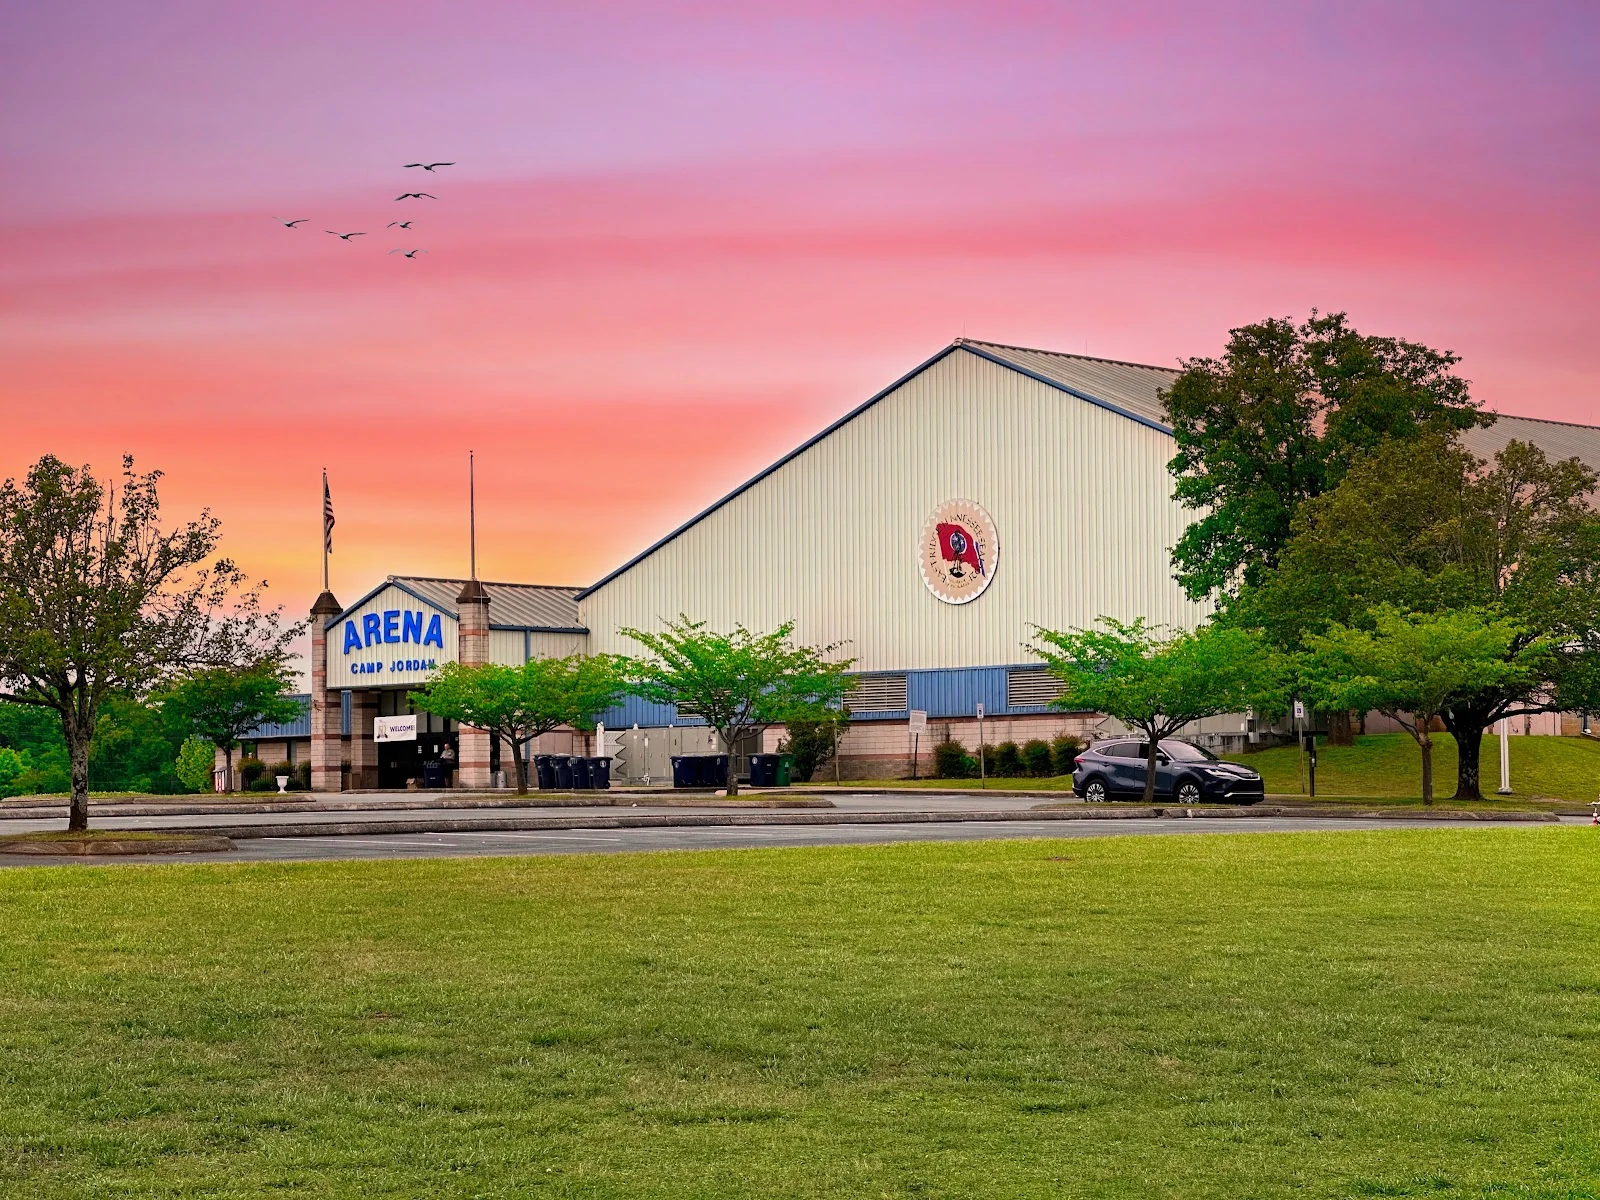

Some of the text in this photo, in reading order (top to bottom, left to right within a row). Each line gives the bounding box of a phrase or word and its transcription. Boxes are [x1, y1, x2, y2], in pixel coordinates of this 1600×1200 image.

[343, 610, 443, 655] ARENA
[350, 659, 435, 674] CAMP JORDAN
